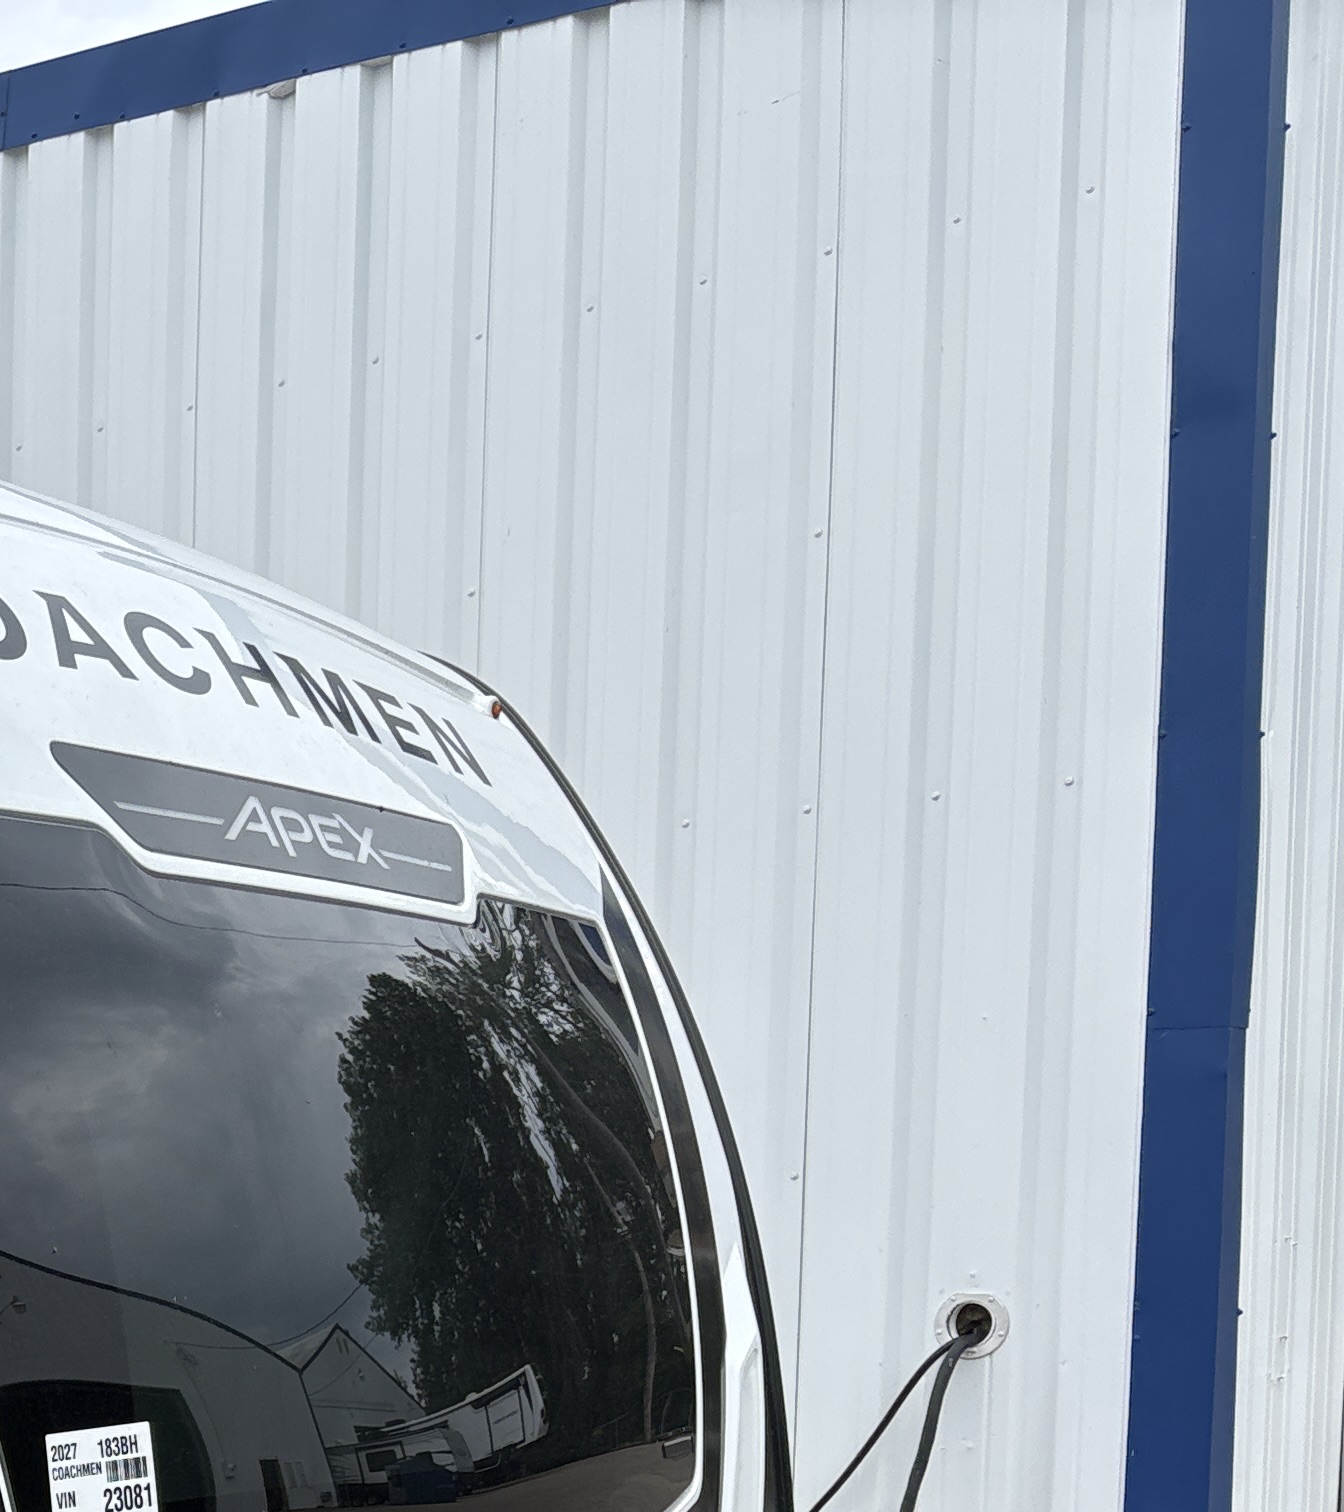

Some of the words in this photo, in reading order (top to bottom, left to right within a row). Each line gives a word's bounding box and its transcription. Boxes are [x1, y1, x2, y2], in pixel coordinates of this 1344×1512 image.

[223, 794, 392, 871] APEX
[50, 1443, 77, 1463] 2027
[97, 1434, 139, 1458] 183BH
[52, 1461, 103, 1481] COACHMEN
[56, 1491, 77, 1509] VIN
[103, 1482, 153, 1512] 23081
